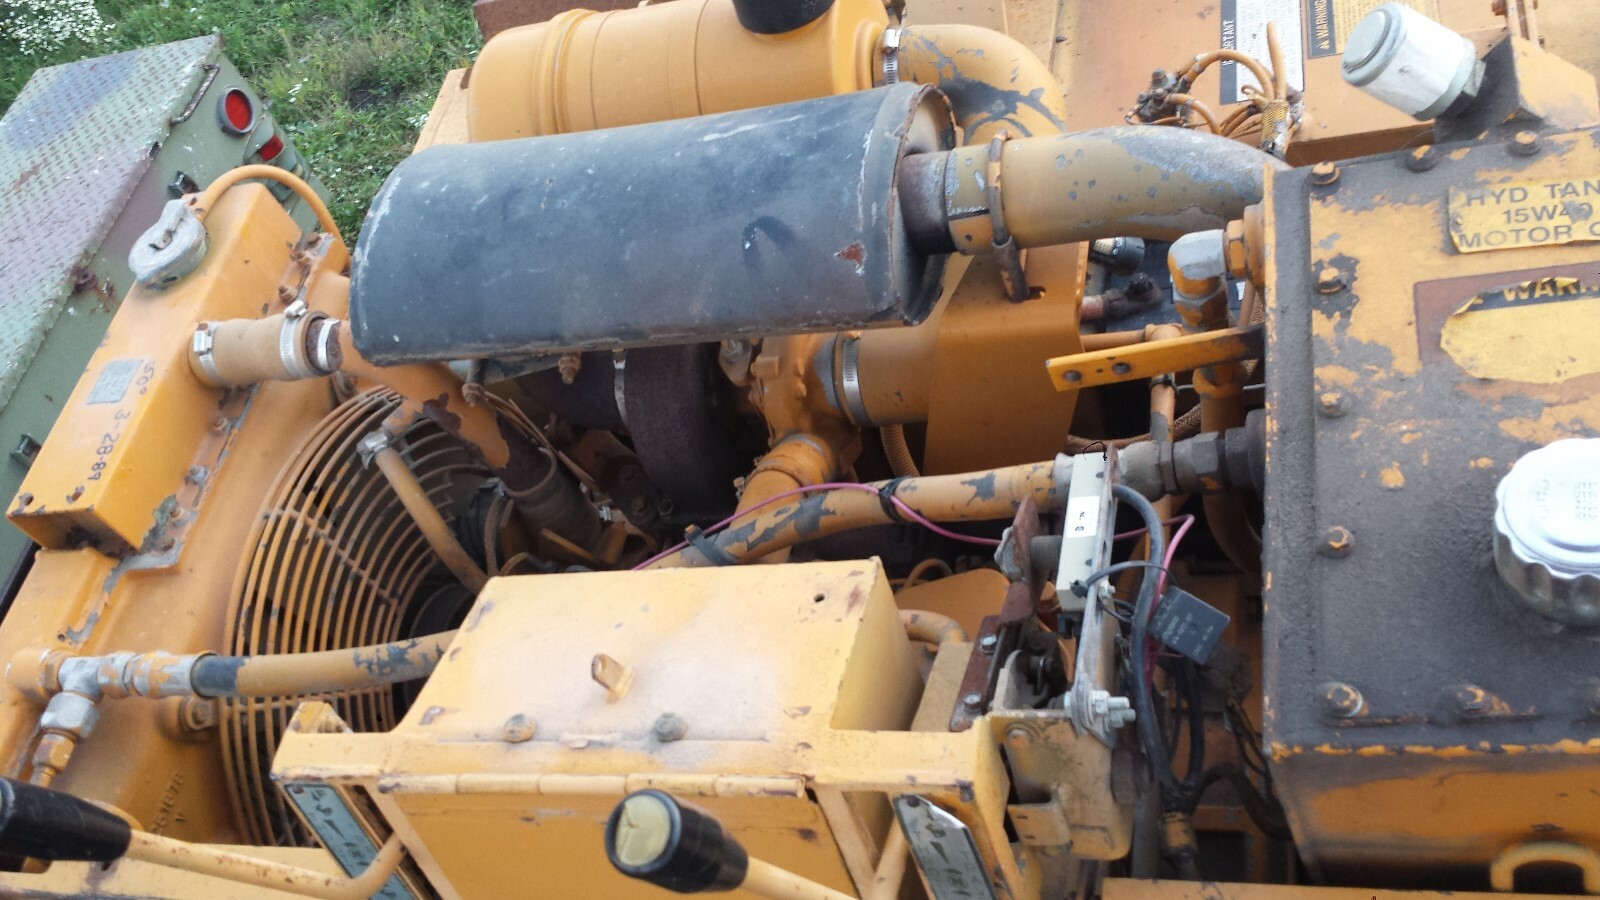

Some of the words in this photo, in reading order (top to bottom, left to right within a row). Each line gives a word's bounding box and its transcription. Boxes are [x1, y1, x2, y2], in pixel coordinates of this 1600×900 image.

[1314, 0, 1329, 39] WARNING
[1466, 187, 1528, 206] HYD
[1458, 225, 1573, 248] MOTOR
[87, 409, 131, 481] 3-28-89
